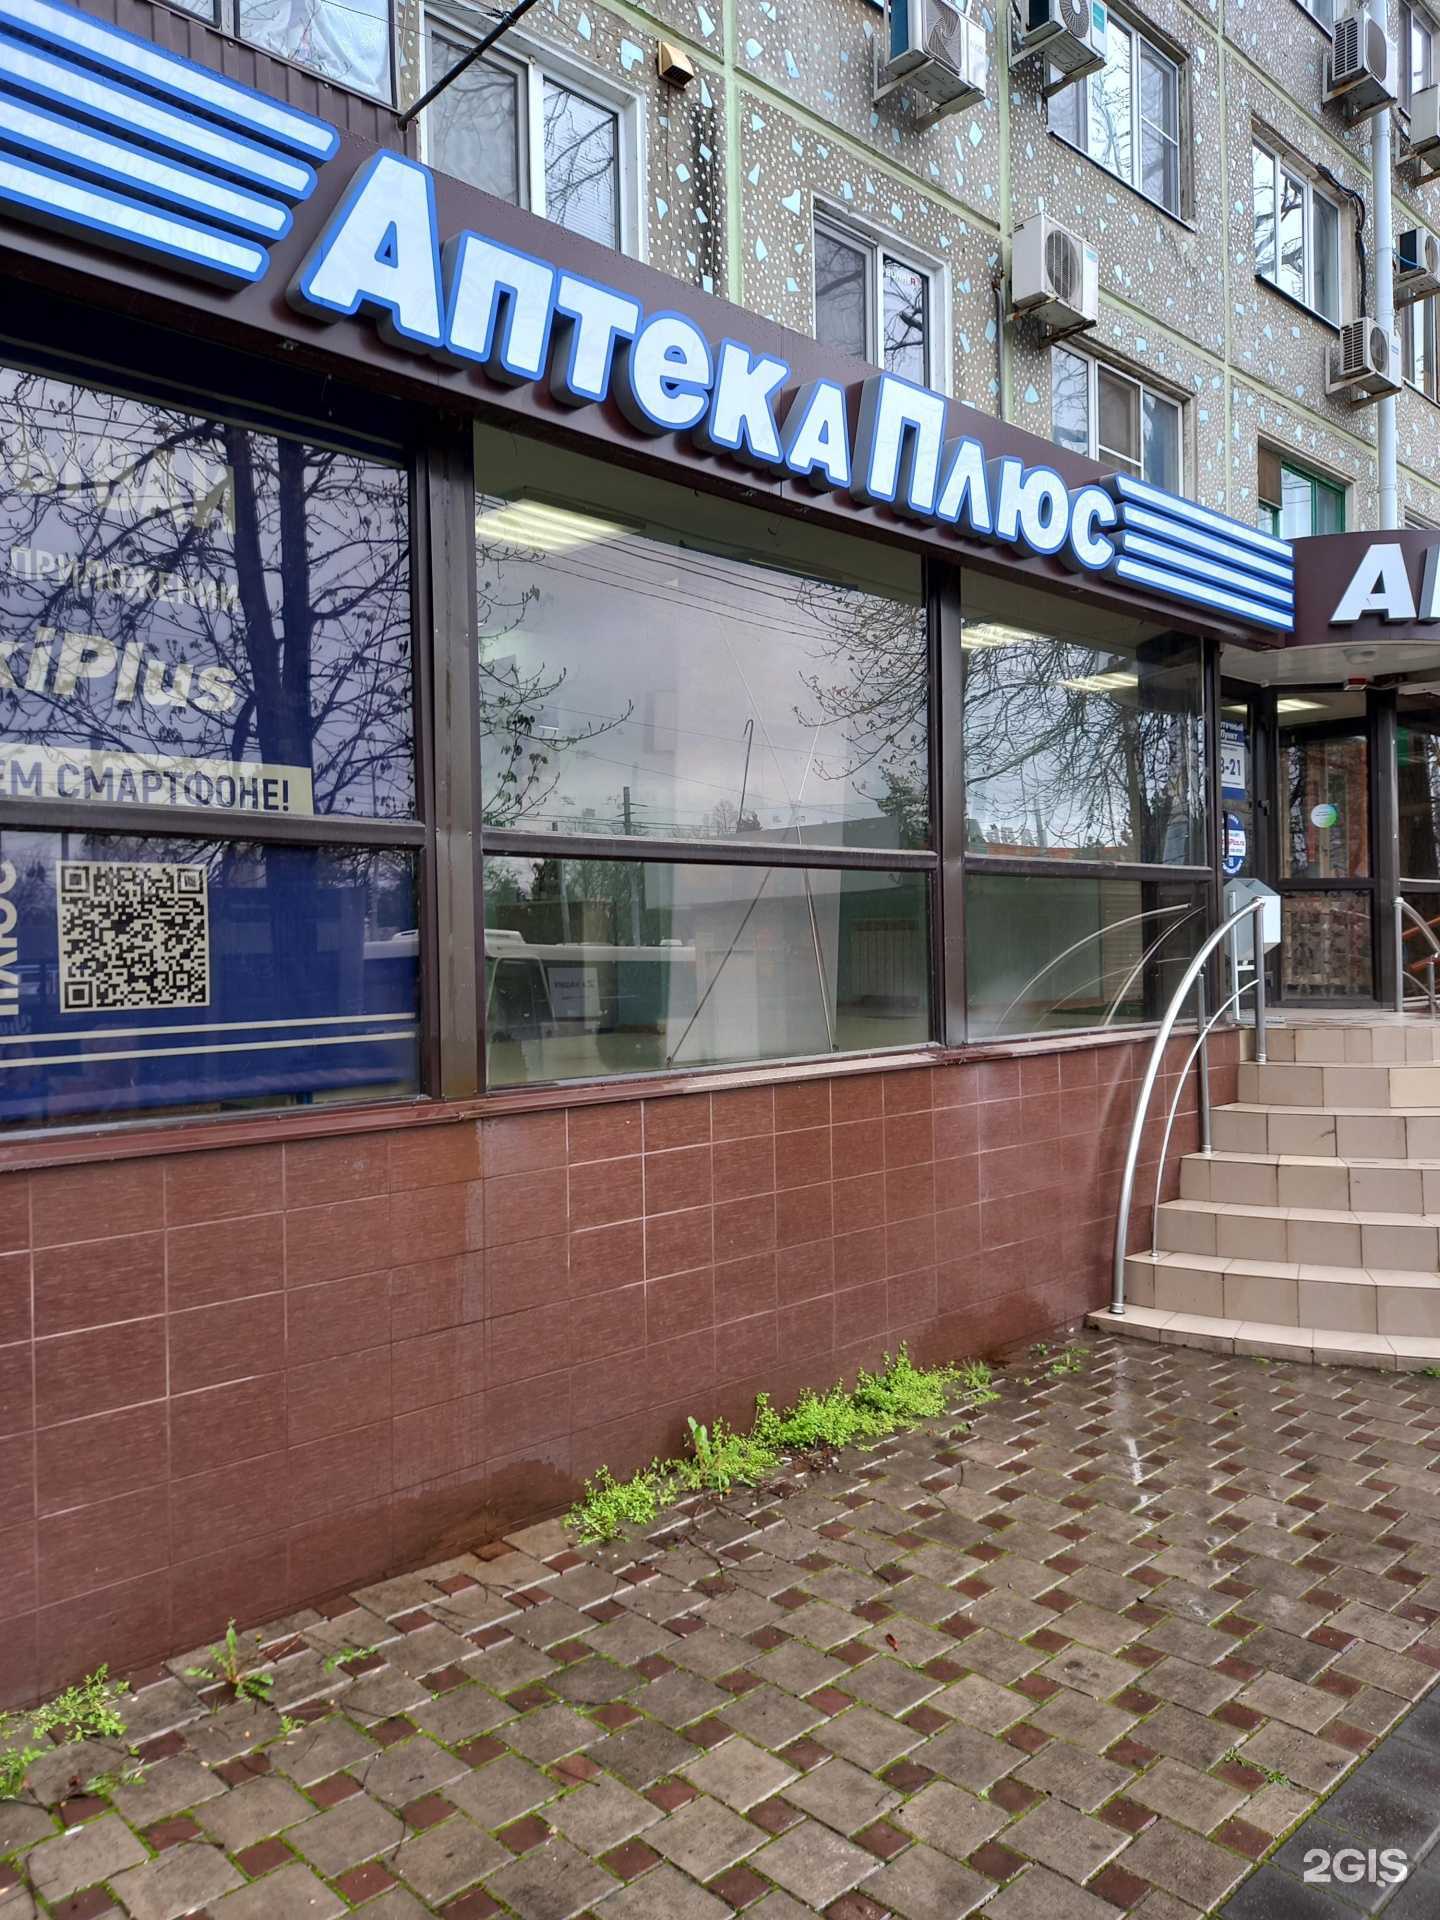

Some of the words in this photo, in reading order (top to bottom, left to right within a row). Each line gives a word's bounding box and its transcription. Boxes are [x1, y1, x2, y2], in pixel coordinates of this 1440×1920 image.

[866, 372, 1118, 570] Плюс
[1329, 542, 1440, 621] А
[57, 763, 289, 811] СМАРТФОНЕ!
